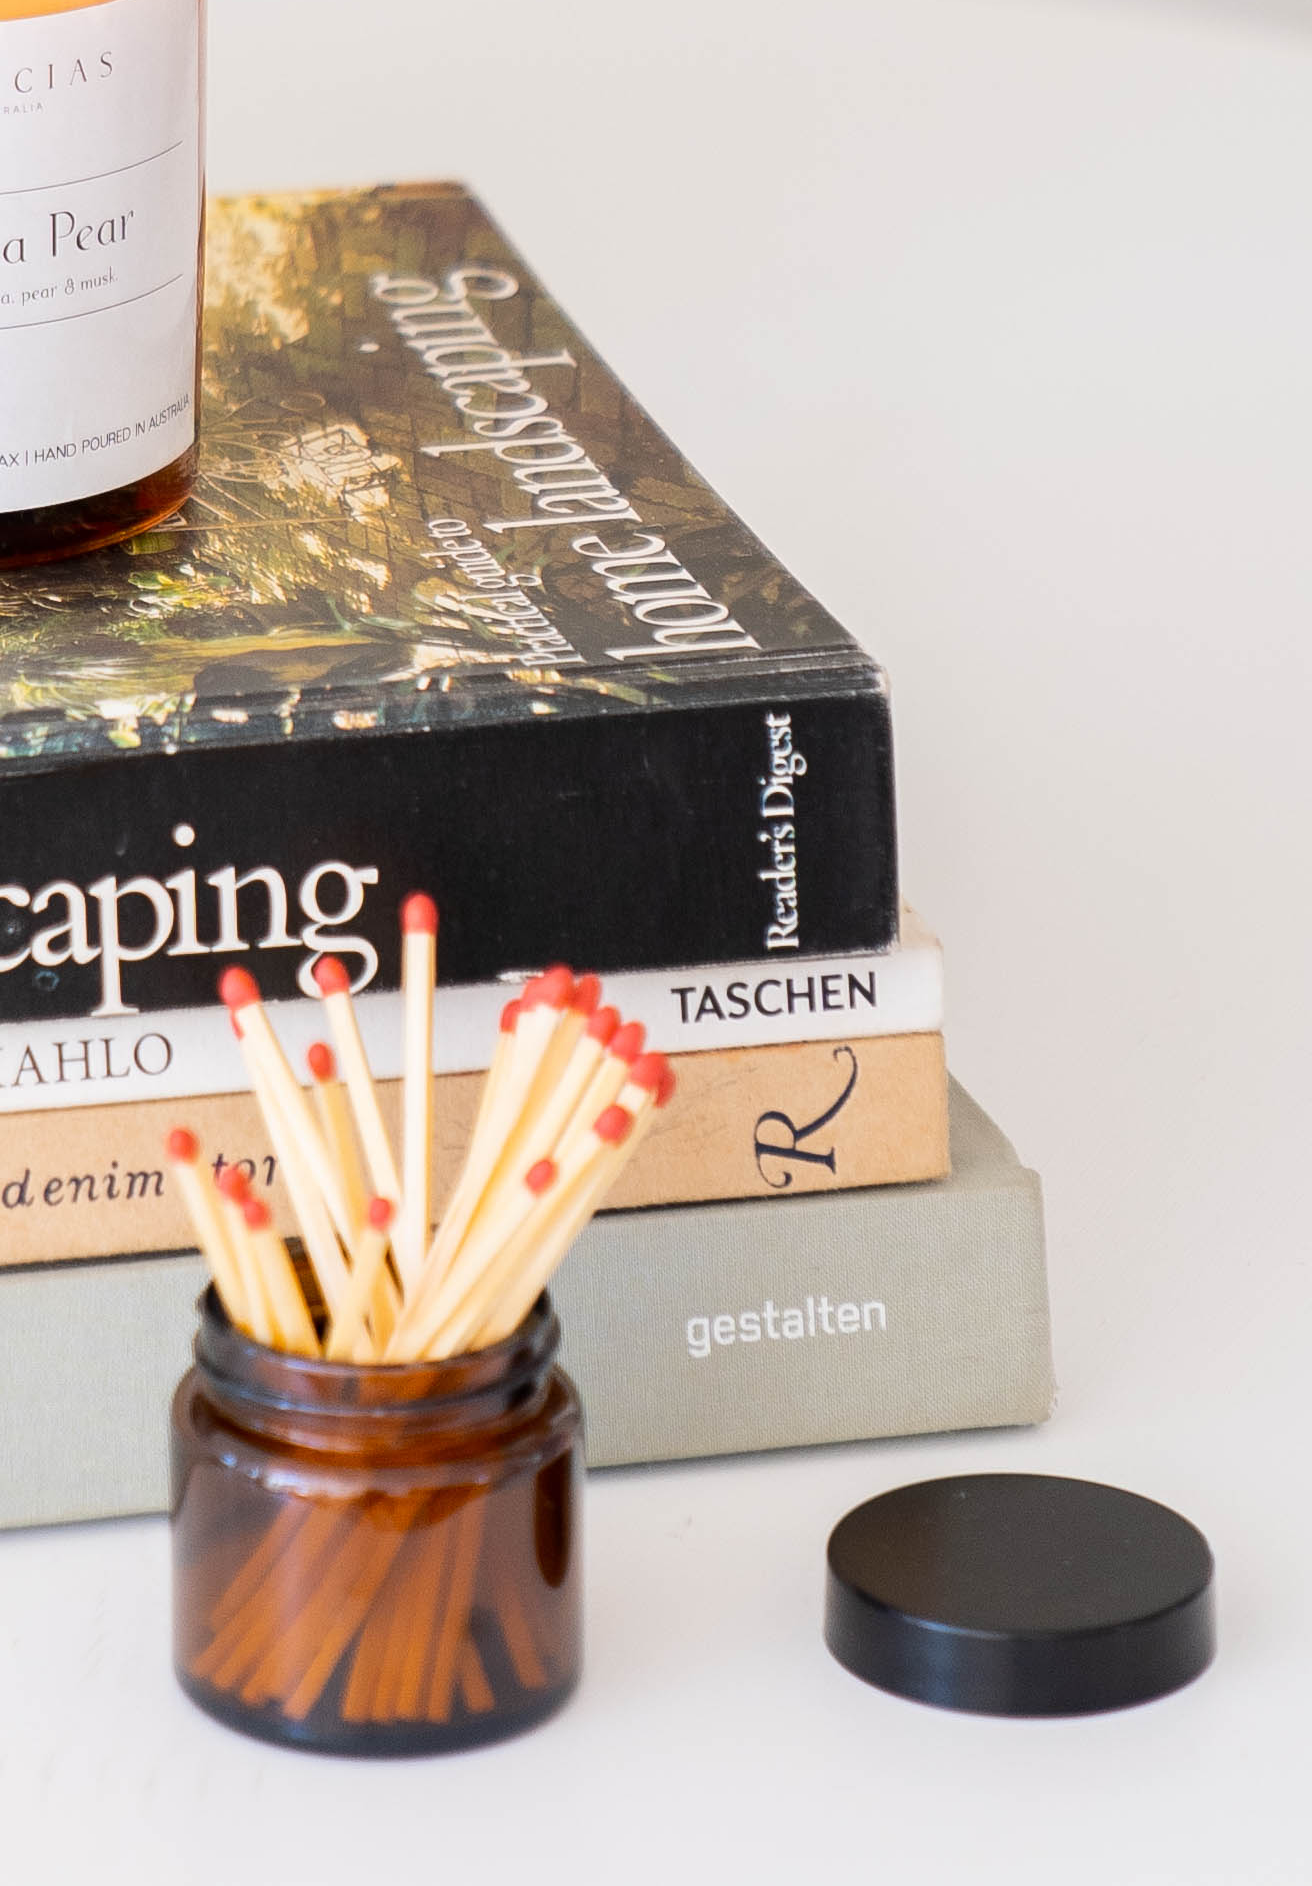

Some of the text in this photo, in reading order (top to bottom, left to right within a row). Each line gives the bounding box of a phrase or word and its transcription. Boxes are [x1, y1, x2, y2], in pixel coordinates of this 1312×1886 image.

[49, 209, 135, 258] Pear
[21, 285, 57, 307] pear
[80, 266, 119, 291] musk.
[34, 443, 77, 463] HAND
[82, 426, 131, 454] POURED
[135, 421, 146, 437] IN
[148, 393, 189, 432] AUSTRALIA
[359, 267, 762, 663] home landscaping
[420, 519, 588, 666] Practical guide to
[757, 712, 807, 950] Reader's Digest
[670, 970, 877, 1024] TASCHEN
[1, 1160, 166, 1210] denim
[688, 1296, 887, 1358] gestalten
